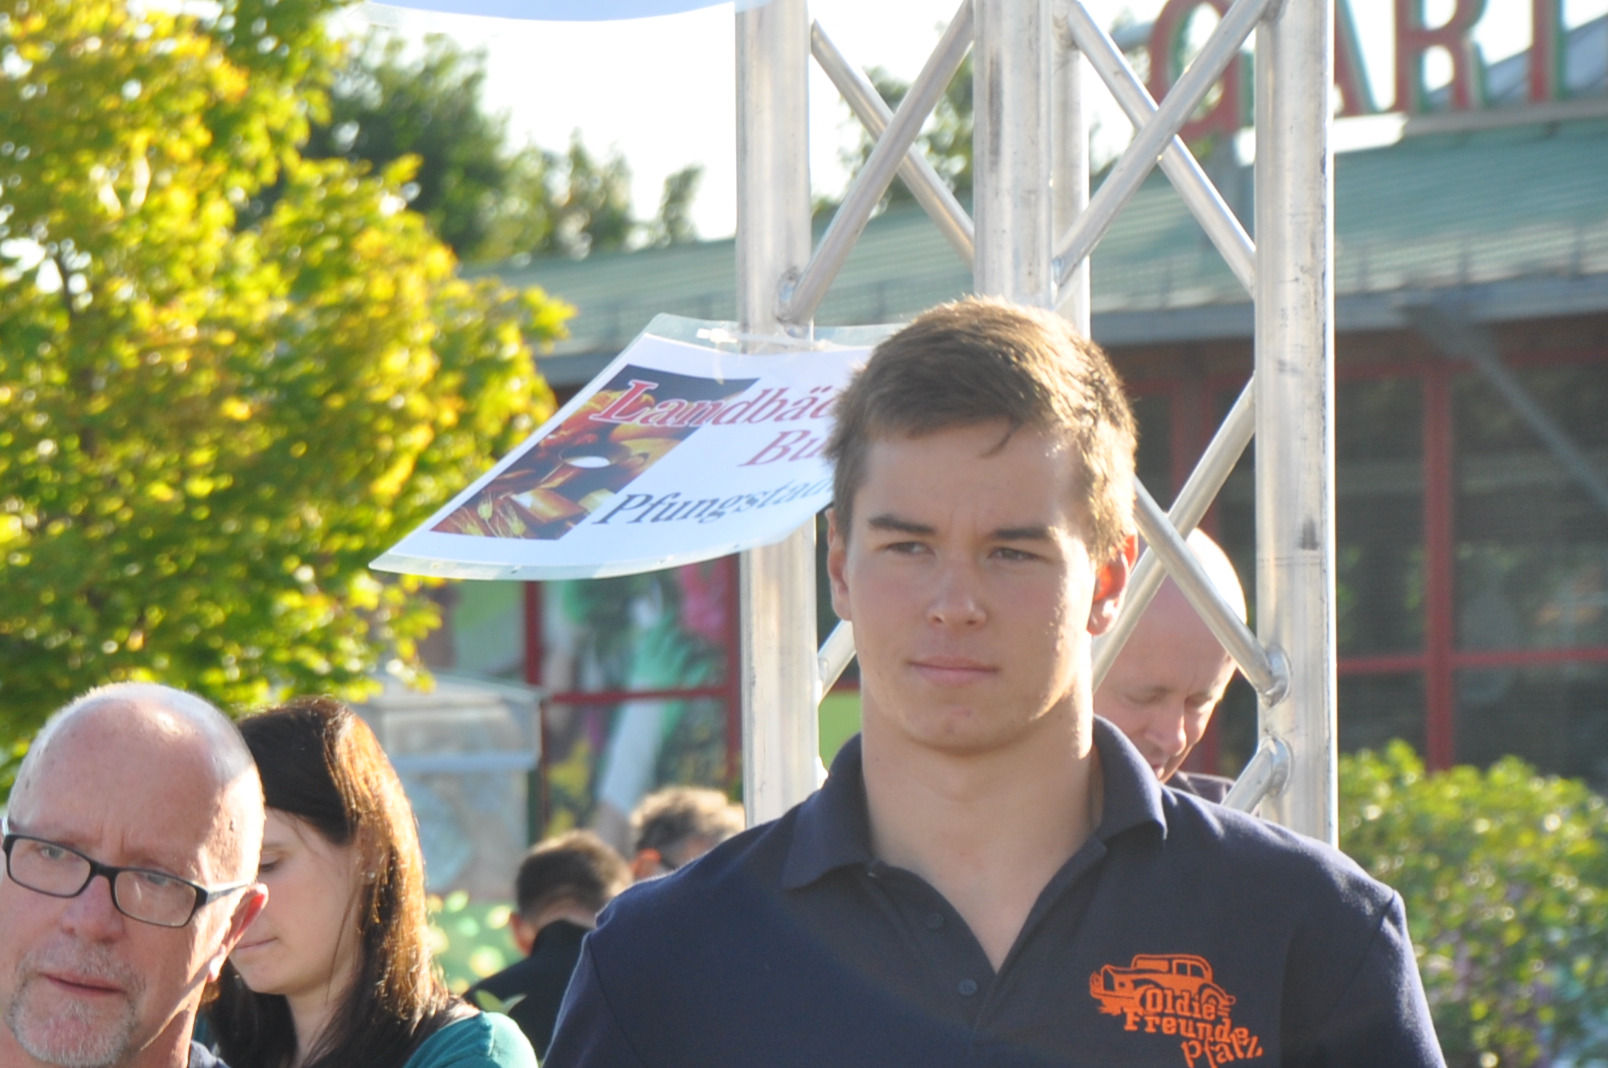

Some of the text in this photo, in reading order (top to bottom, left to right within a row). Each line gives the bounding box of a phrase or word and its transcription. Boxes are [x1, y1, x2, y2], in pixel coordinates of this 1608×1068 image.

[589, 378, 839, 427] Landbäc
[737, 429, 826, 468] Bu
[1144, 987, 1217, 1021] Oldie
[1123, 1006, 1250, 1045] Freunde
